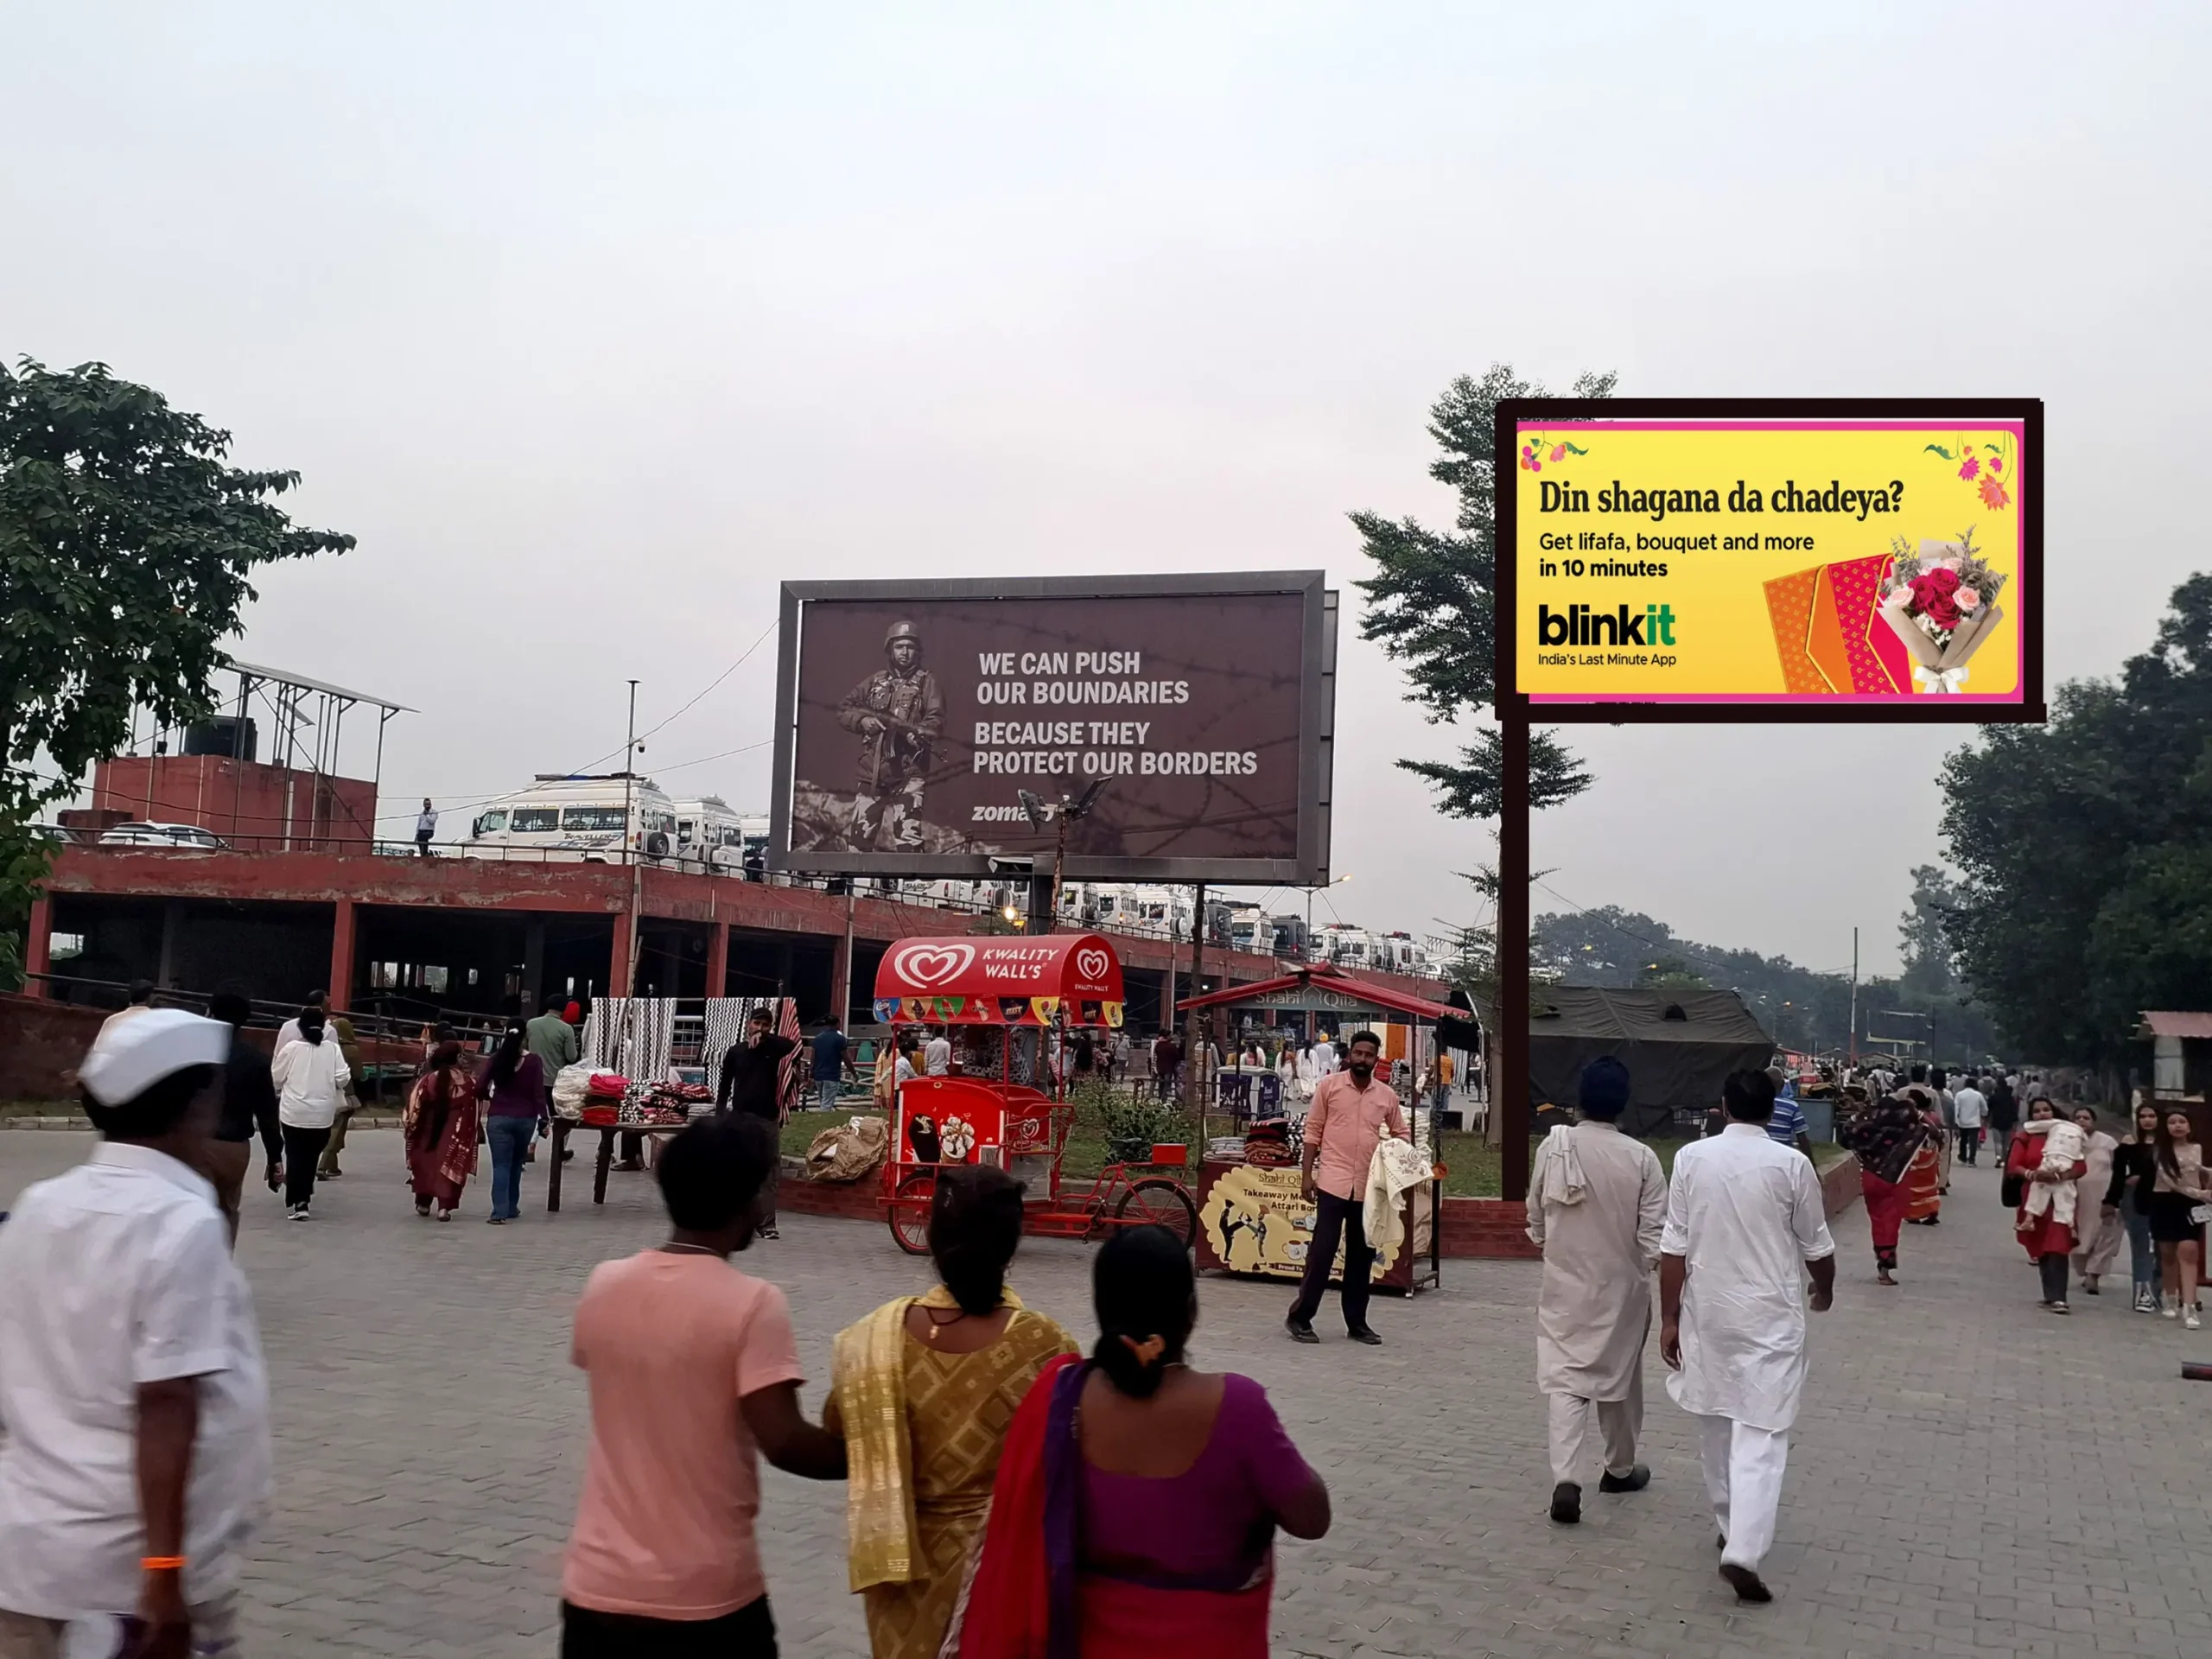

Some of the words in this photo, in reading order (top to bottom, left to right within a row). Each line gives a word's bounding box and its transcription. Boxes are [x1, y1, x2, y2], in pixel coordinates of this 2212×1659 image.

[1540, 480, 1591, 512] Din
[1598, 480, 1721, 522] shagana
[1727, 480, 1764, 513] da
[1770, 480, 1904, 522] chadeya?
[1539, 532, 1573, 550] Get
[1579, 531, 1630, 553] lifafa,
[1637, 532, 1718, 554] bouquet
[1723, 532, 1758, 550] and
[1764, 537, 1815, 550] more
[1540, 559, 1557, 577] in
[1562, 559, 1585, 577] 10
[1590, 558, 1669, 577] minutes
[1538, 603, 1676, 646] blinkit
[978, 652, 1016, 676] WE
[1020, 652, 1069, 675] CAN
[1075, 652, 1141, 675] PUSH
[1538, 652, 1576, 665] India's
[1579, 653, 1605, 665] Last
[1607, 652, 1648, 665] Minute
[1650, 653, 1677, 668] App
[976, 682, 1027, 705] OUR
[1033, 680, 1189, 704] BOUNDARIES
[975, 721, 1084, 745] BECAUSE
[1088, 721, 1151, 745] THEY
[973, 751, 1078, 774] PROTECT
[1083, 751, 1134, 775] OUR
[1141, 751, 1257, 775] BORDERS
[971, 805, 1055, 823] zoma
[982, 948, 1059, 961] KWALITY
[986, 963, 1042, 979] WALL'S
[1243, 1188, 1289, 1202] Takeaway
[1271, 1201, 1299, 1211] Attari
